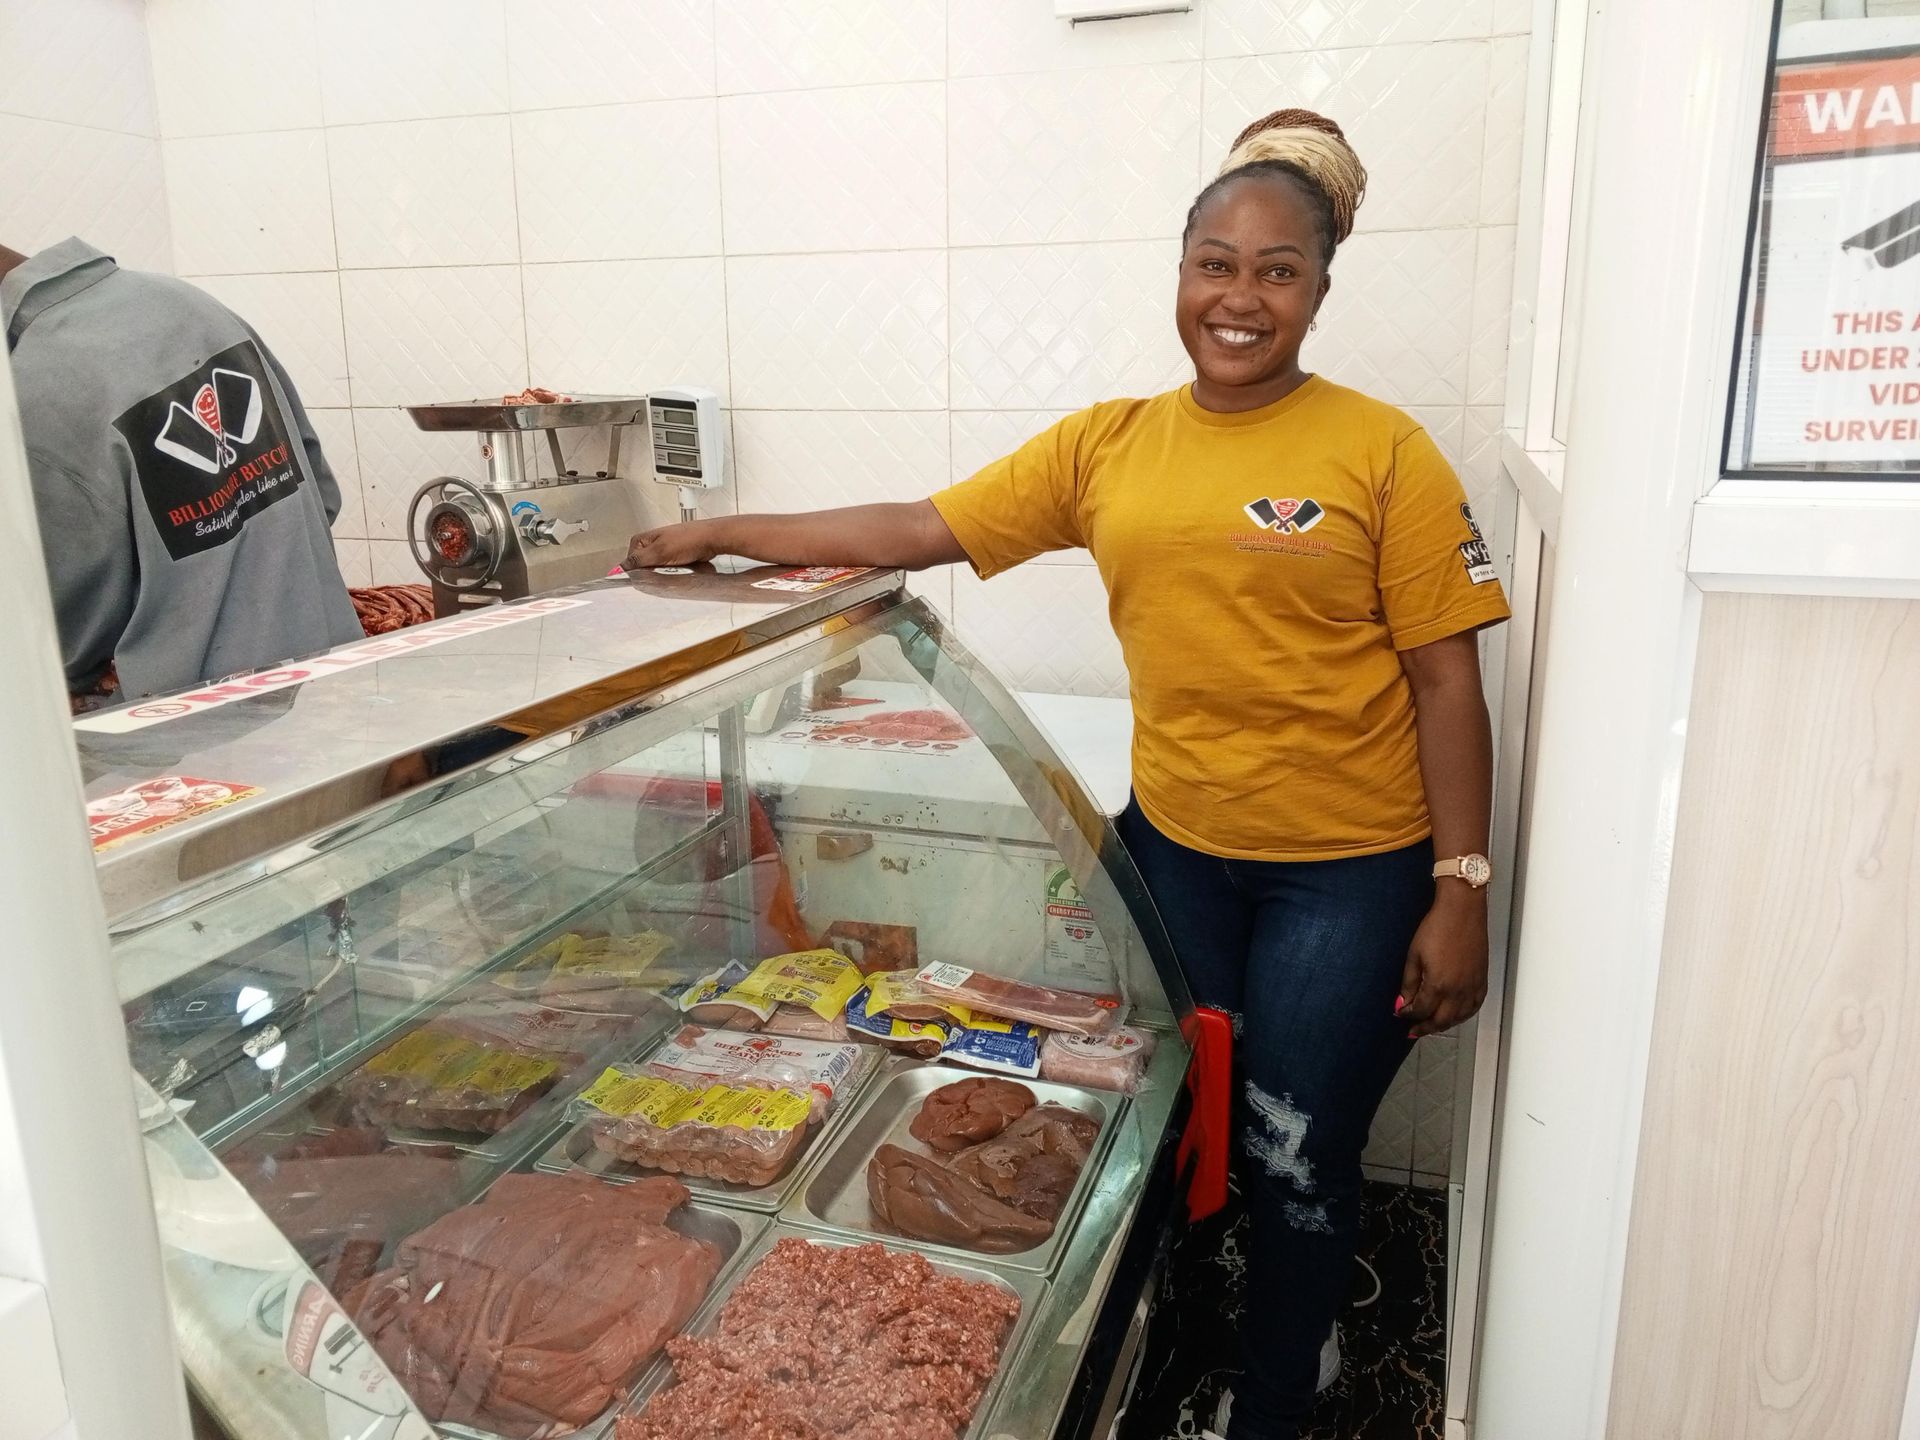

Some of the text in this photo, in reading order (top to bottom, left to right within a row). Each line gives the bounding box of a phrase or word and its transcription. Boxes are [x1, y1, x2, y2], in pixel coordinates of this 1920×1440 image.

[1832, 310, 1903, 335] THIS
[1801, 346, 1909, 372] UNDER
[1805, 418, 1920, 442] SURVEI
[256, 475, 279, 494] like
[177, 600, 574, 703] NO LEANING
[713, 1042, 803, 1058] BEEF SASAGES
